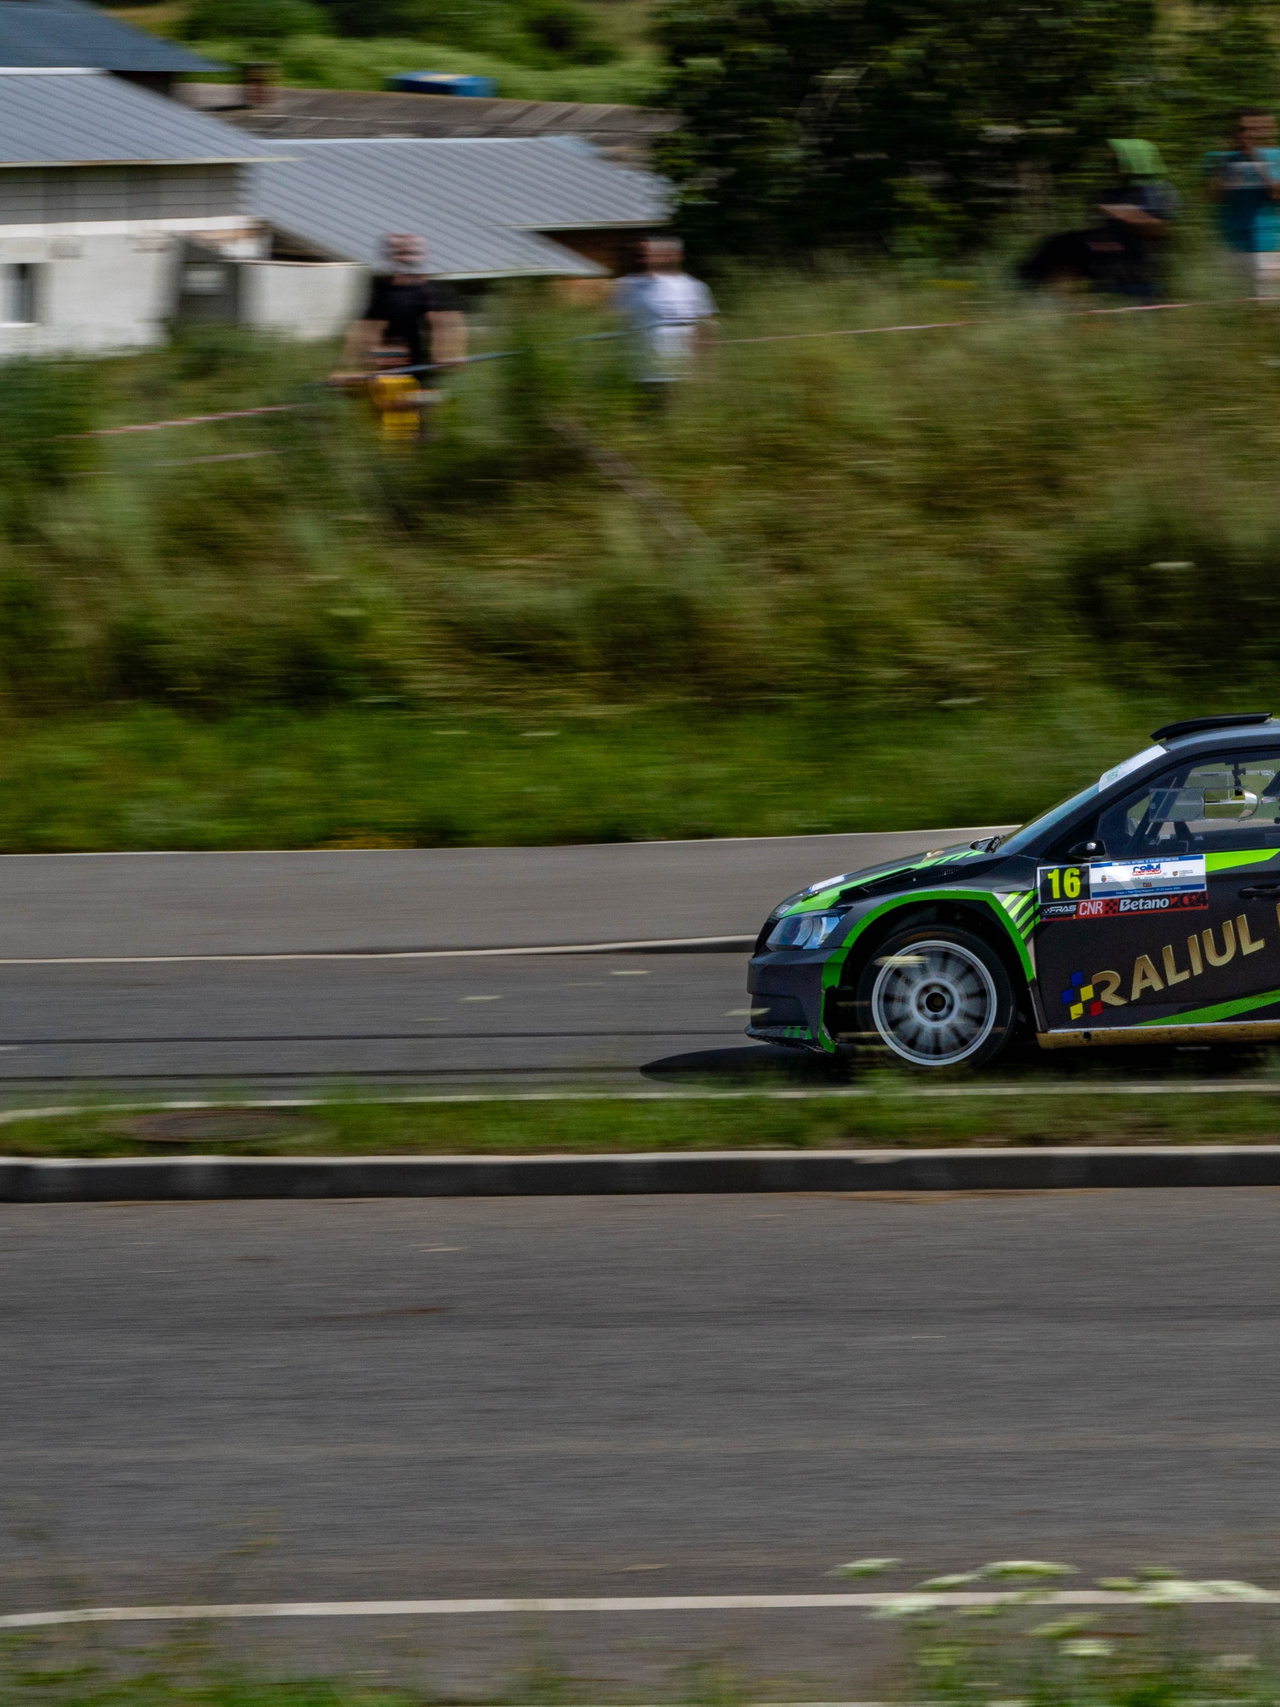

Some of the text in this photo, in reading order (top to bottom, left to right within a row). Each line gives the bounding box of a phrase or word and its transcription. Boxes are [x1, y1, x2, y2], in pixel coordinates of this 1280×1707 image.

[1047, 867, 1081, 899] 16
[1049, 904, 1077, 913] FRAS
[1079, 901, 1104, 916] CNR
[1119, 897, 1170, 912] Betano
[1090, 914, 1265, 1006] RALIUL
